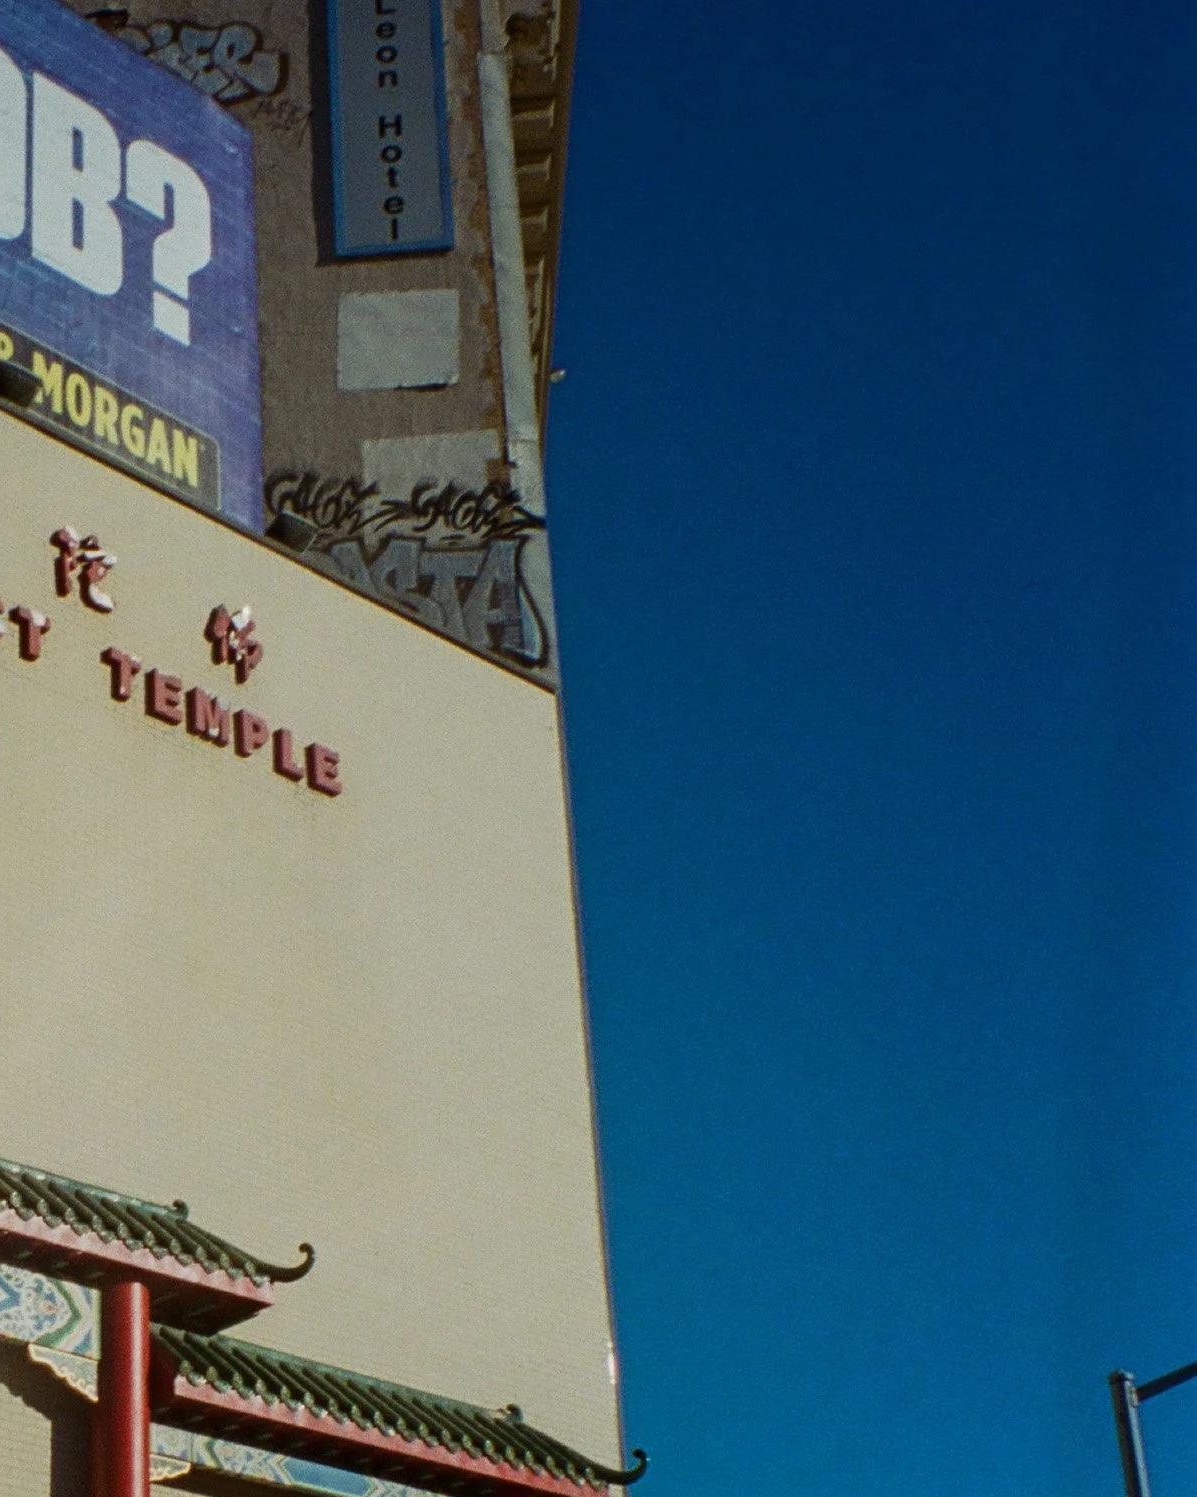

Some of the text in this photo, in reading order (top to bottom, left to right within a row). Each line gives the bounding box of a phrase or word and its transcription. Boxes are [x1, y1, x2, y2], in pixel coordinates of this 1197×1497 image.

[378, 113, 405, 241] Hotel
[31, 350, 200, 487] MORGAN
[99, 646, 343, 798] TEMPLE
